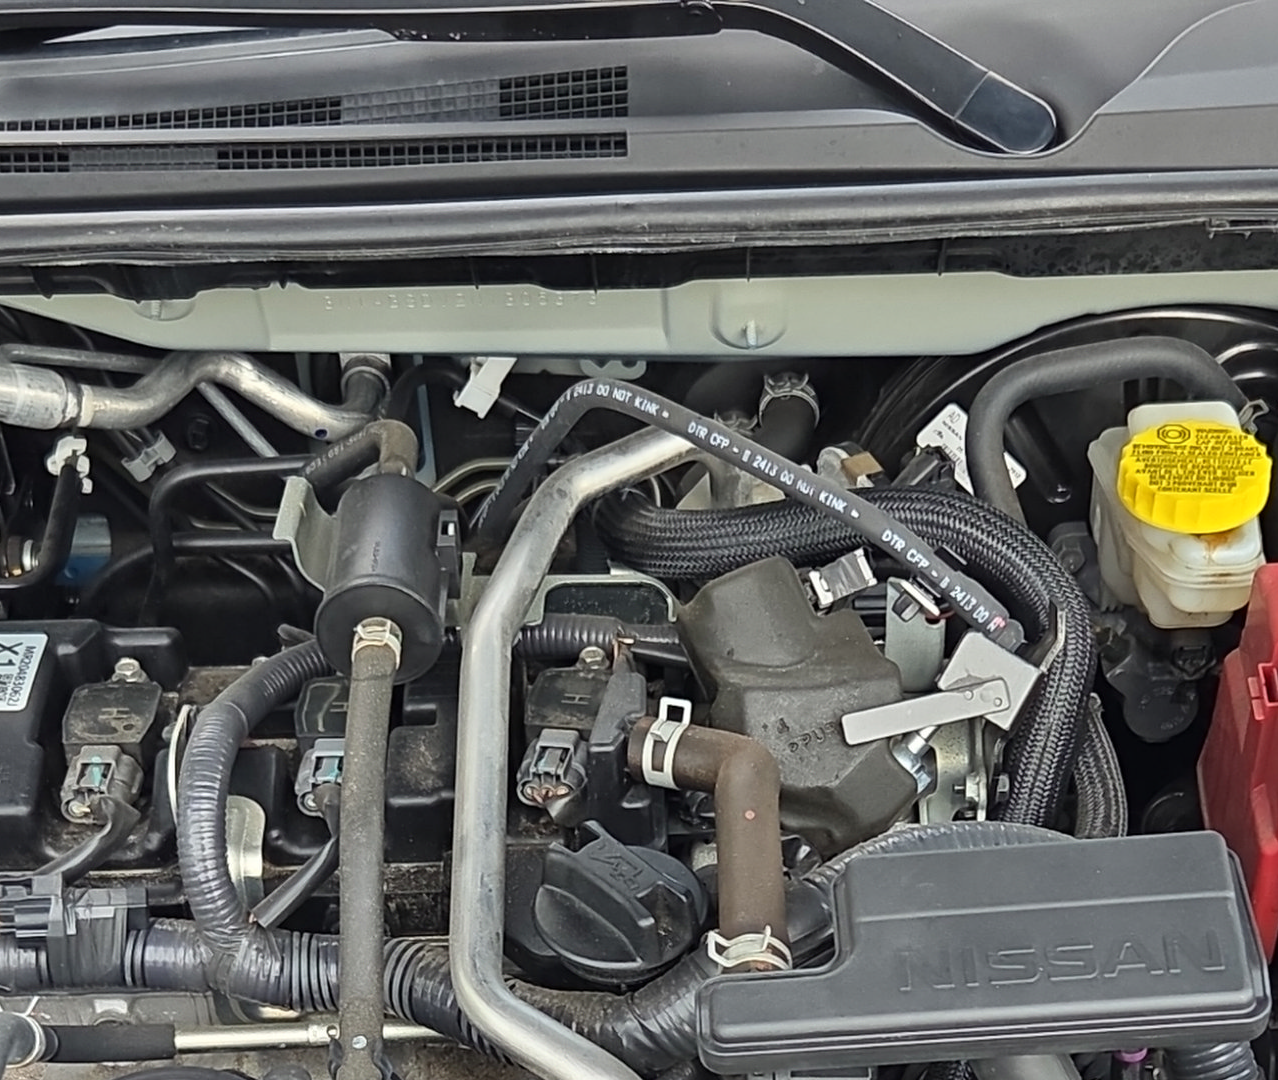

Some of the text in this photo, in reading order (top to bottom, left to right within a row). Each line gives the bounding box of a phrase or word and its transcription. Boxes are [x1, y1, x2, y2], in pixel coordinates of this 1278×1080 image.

[634, 396, 660, 416] KINK
[818, 489, 848, 513] KINK
[881, 529, 906, 554] DTR
[906, 548, 931, 569] CFP
[899, 929, 1225, 991] NISSAN
